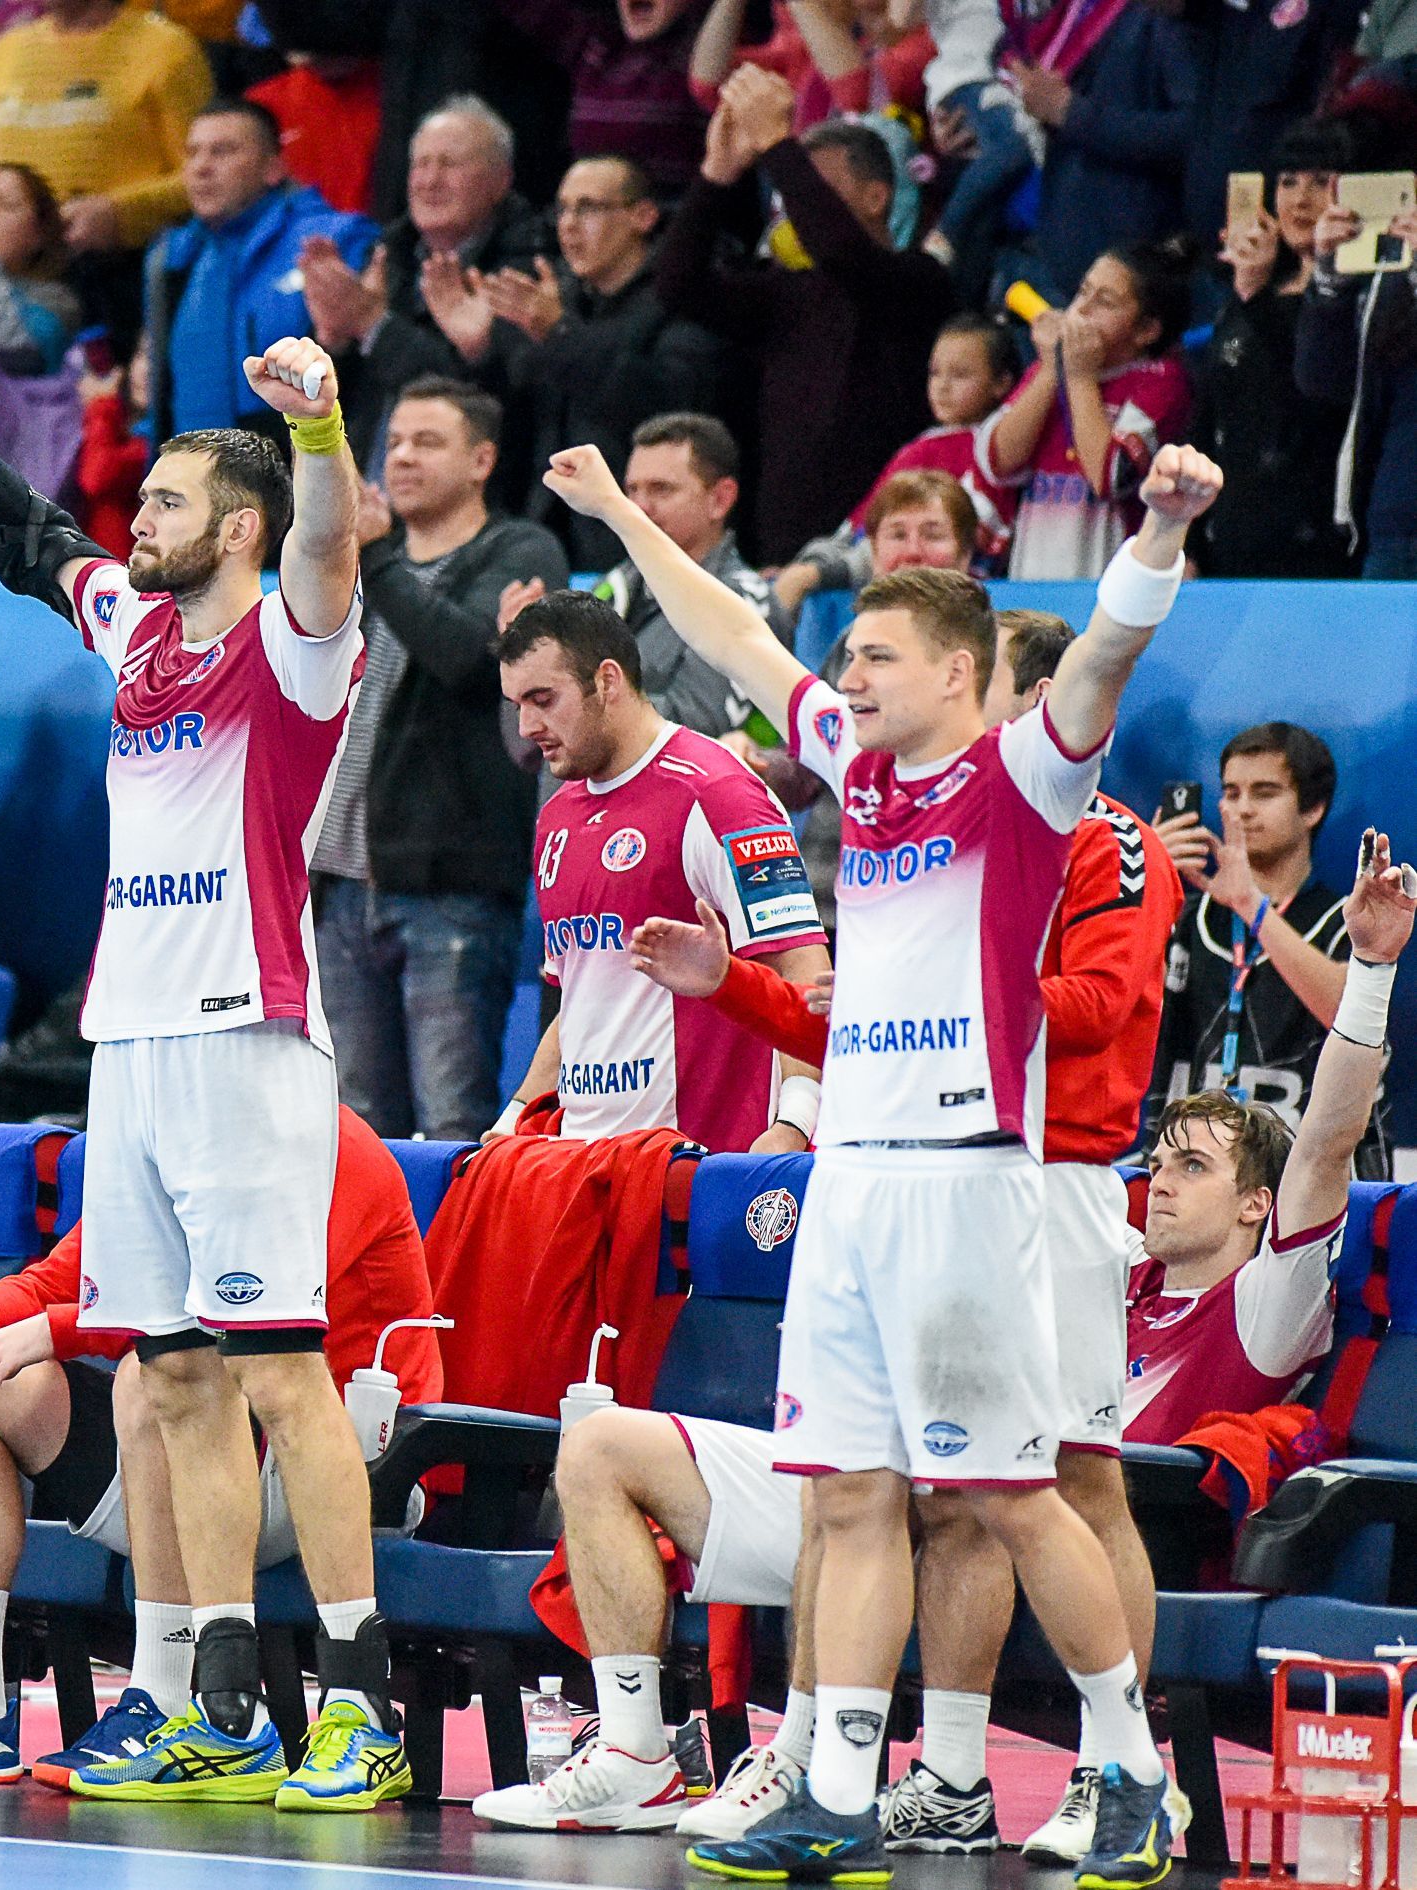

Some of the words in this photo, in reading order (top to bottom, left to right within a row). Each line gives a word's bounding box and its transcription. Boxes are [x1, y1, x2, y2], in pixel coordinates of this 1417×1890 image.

[538, 828, 569, 890] 43
[737, 836, 796, 858] VELUX
[841, 835, 956, 889] MOTOR
[559, 1057, 655, 1095] R-GARANT
